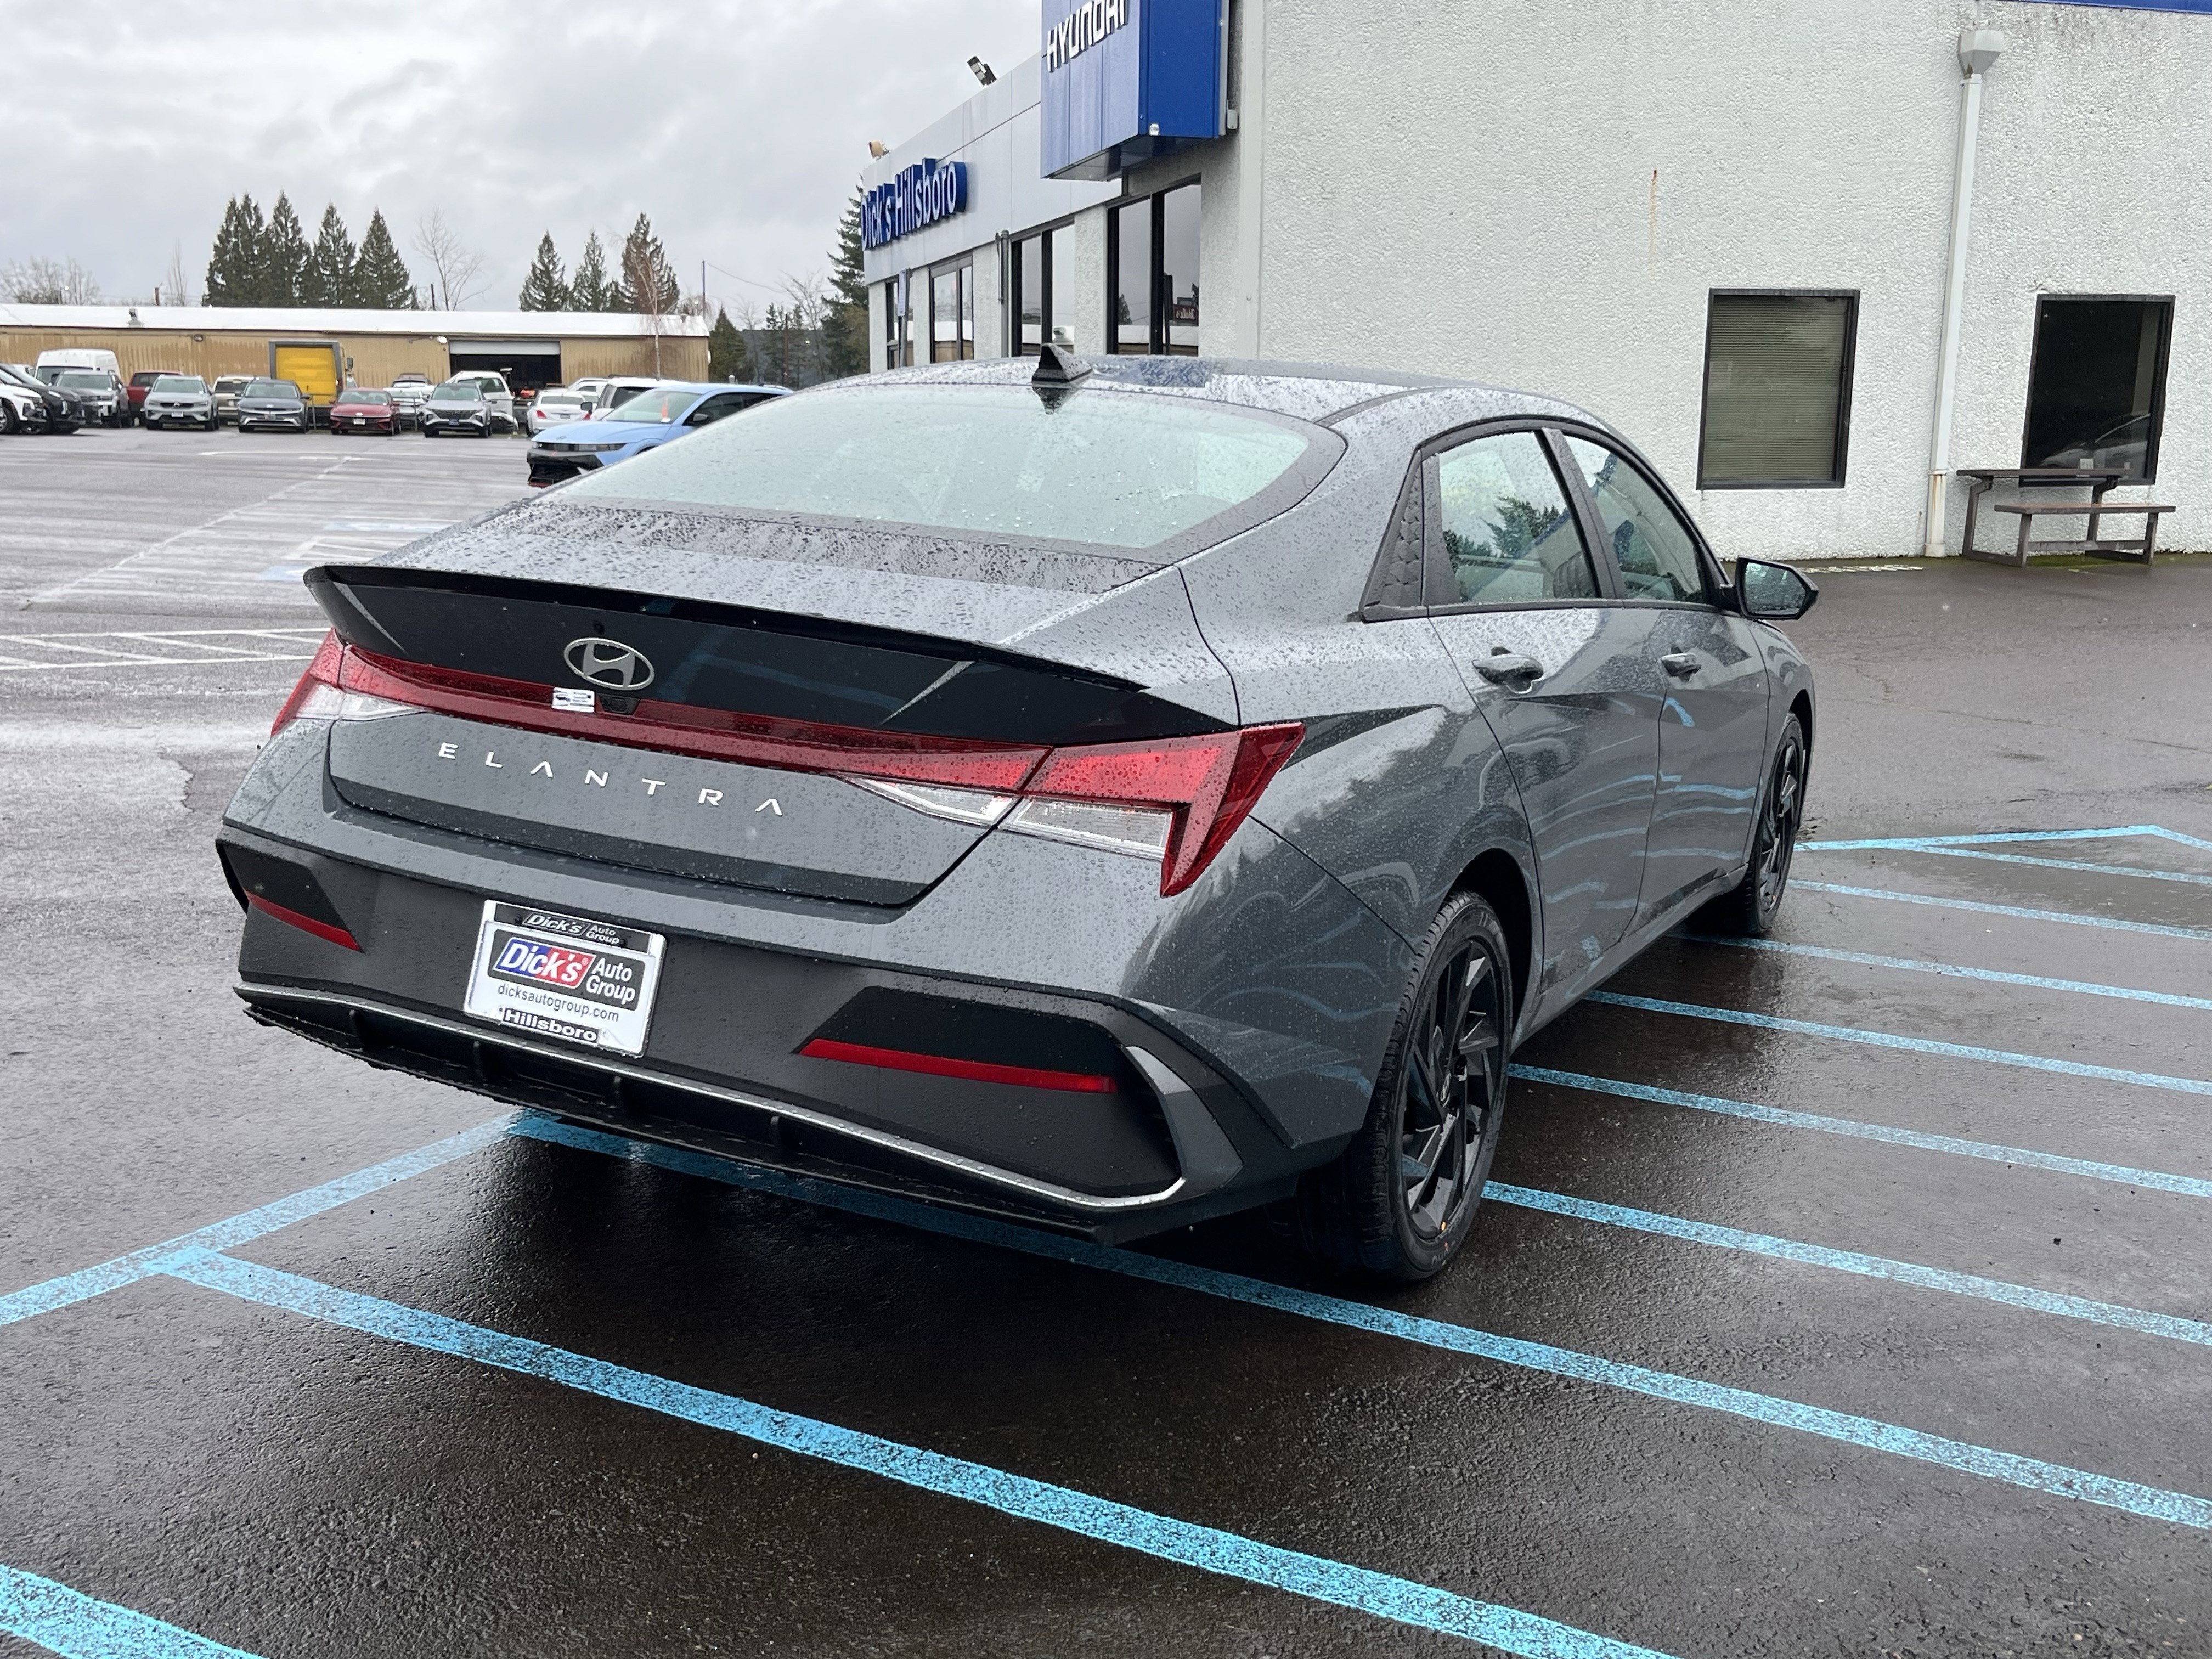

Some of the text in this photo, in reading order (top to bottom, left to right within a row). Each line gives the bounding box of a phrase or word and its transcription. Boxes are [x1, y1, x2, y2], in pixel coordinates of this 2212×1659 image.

[861, 158, 958, 251] Dick's Hillsboro
[438, 742, 783, 816] ELANTRA
[527, 915, 583, 933] Dick's
[585, 931, 620, 945] Group
[589, 924, 616, 936] Auto
[500, 943, 583, 983] Dick's
[591, 957, 633, 981] Auto
[498, 983, 619, 1023] dicksautogroup.com
[586, 975, 636, 1005] Group
[504, 1008, 598, 1041] Hillsboro
